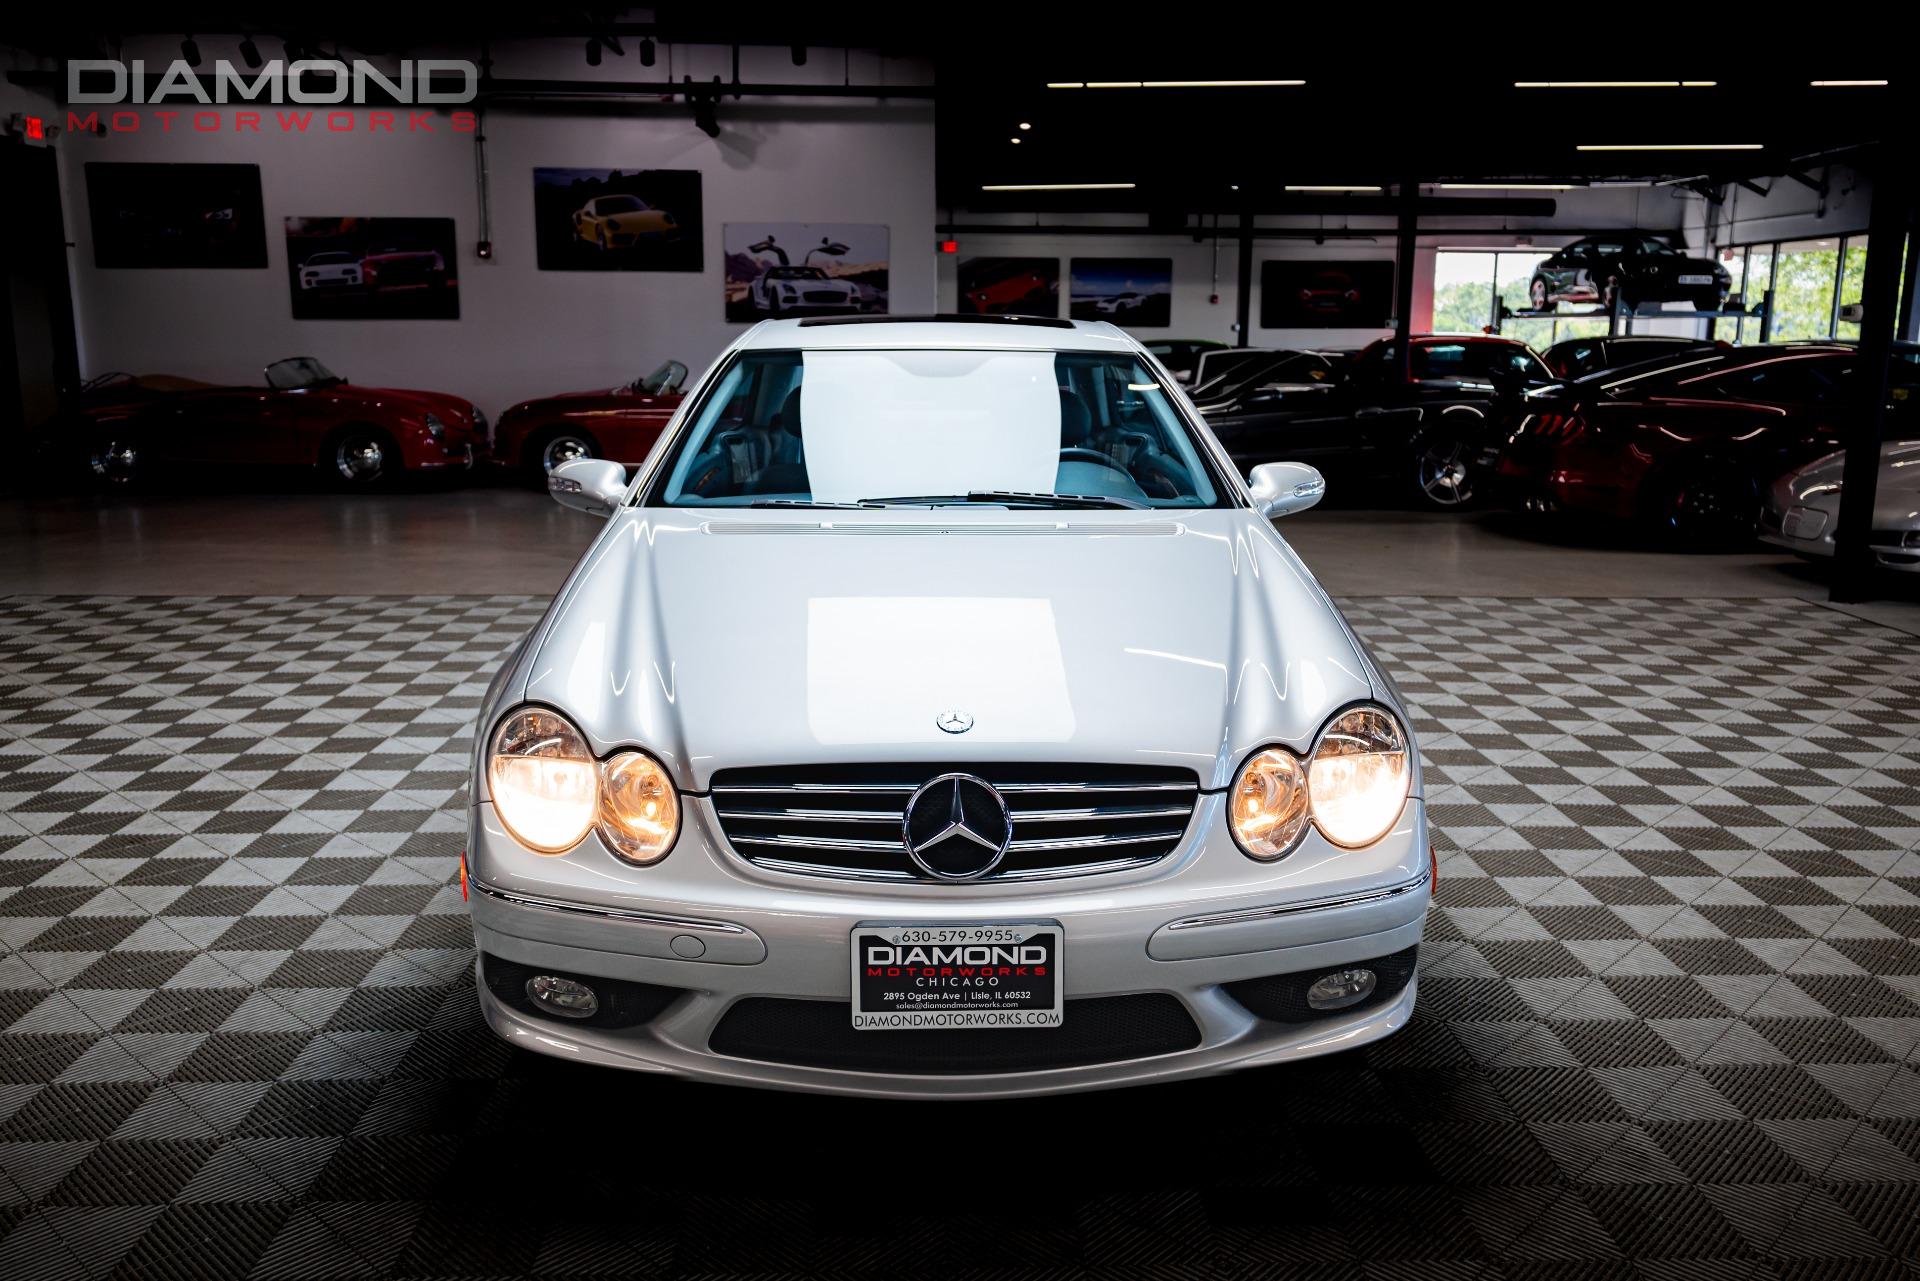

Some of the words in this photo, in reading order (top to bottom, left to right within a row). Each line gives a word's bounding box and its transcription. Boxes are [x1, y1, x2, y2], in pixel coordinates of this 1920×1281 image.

[902, 930, 1013, 942] 630-579-9955
[867, 946, 1047, 965] DIAMOND
[867, 967, 1046, 976] MOTORWORKS
[915, 977, 999, 987] CHICAGO
[883, 992, 905, 1001] 2895
[907, 992, 940, 1002] Ogden
[942, 992, 960, 1000] Ave
[971, 992, 993, 1001] Lisle,
[995, 991, 1002, 999] IL
[1004, 991, 1031, 999] 60532
[896, 1001, 1019, 1010] sales@diamondmotorworks.com
[854, 1013, 1060, 1027] DIAMONDMOTORWORKS.COM
